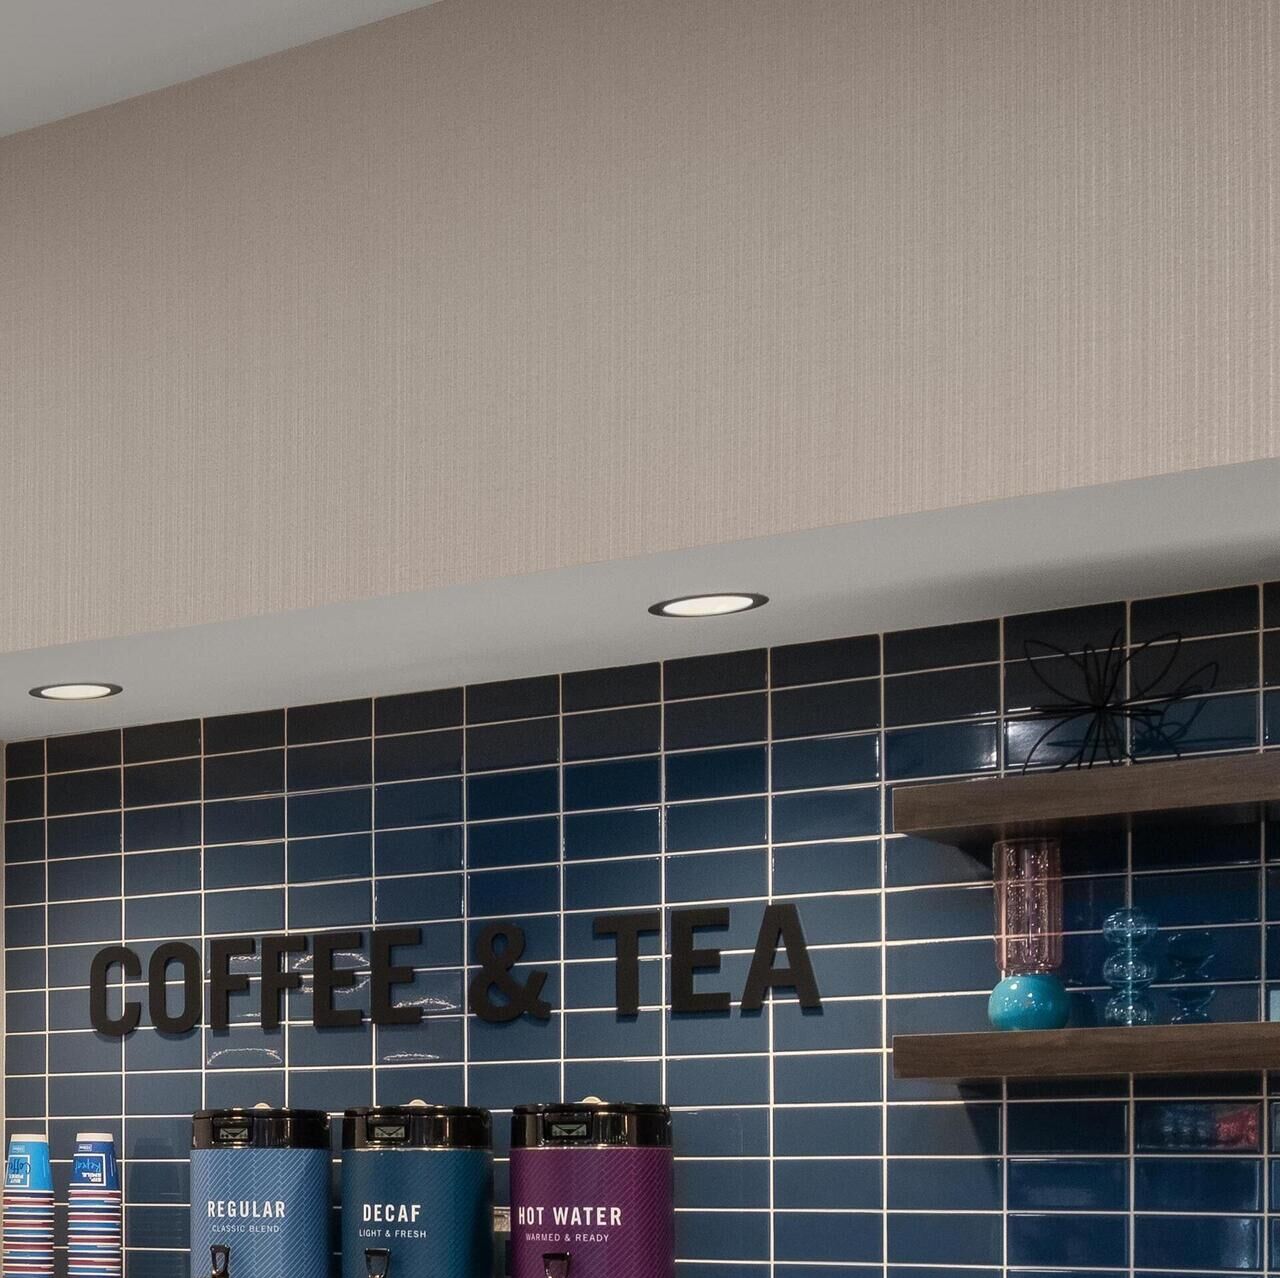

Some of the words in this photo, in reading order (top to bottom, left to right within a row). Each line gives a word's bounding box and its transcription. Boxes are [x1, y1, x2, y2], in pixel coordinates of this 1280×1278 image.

[90, 928, 424, 1037] COFFEE
[469, 922, 552, 1023] &
[592, 903, 823, 1016] TEA
[207, 1200, 286, 1218] REGULAR
[362, 1204, 422, 1223] DECAF
[518, 1206, 545, 1225] HOT
[552, 1206, 622, 1226] WATER
[211, 1224, 245, 1233] CLASSIC
[249, 1225, 280, 1234] BLEND
[359, 1229, 382, 1238] LIGHT
[385, 1230, 391, 1238] &
[394, 1230, 427, 1239] FRESH
[525, 1233, 561, 1242] WARMED
[564, 1233, 571, 1242] &
[575, 1233, 609, 1243] READY
